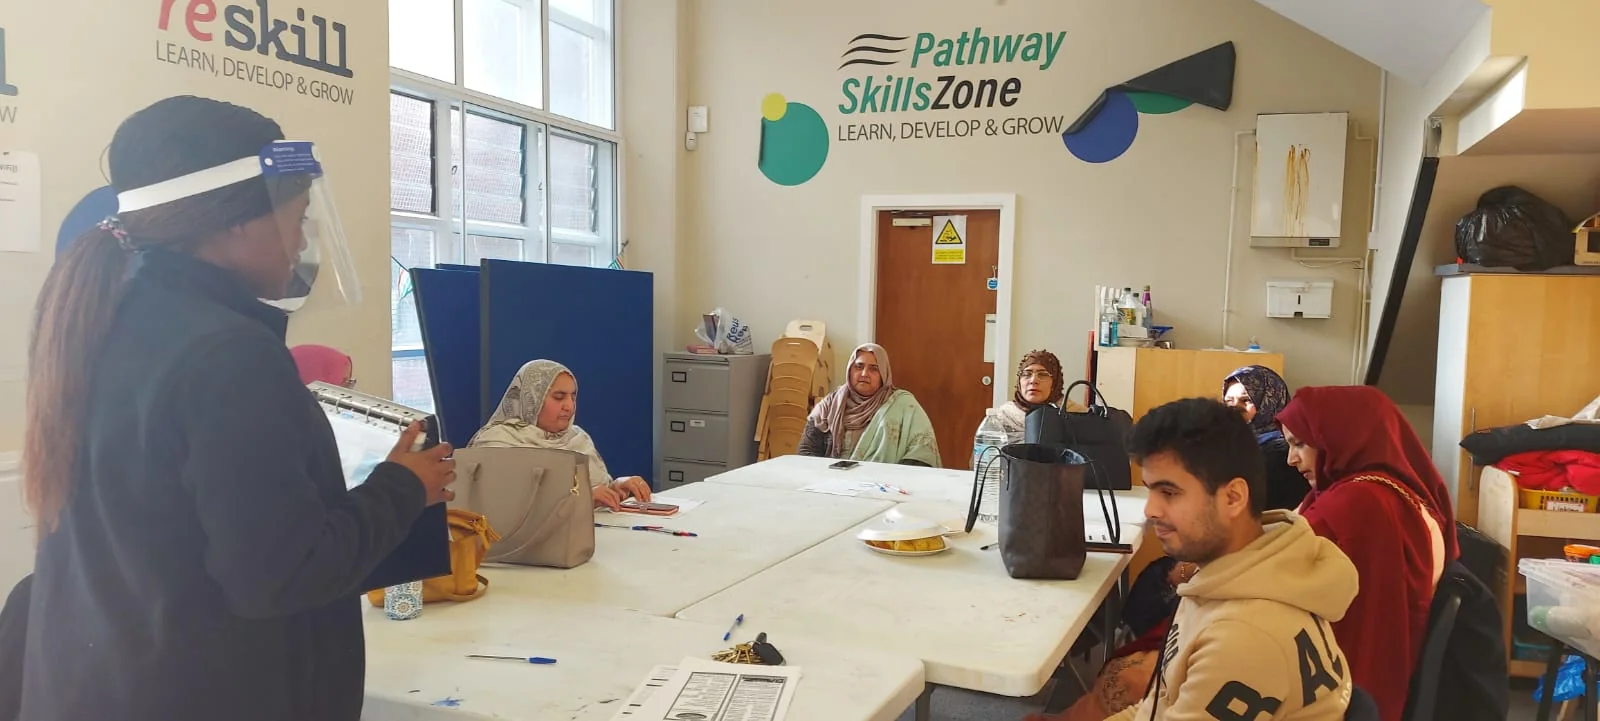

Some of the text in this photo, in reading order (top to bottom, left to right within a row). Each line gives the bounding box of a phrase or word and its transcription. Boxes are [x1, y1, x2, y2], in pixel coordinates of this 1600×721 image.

[911, 27, 1066, 70] Pathway
[156, 40, 354, 105] LEARN, DEVELOP & GROW
[838, 75, 1021, 114] SkillsZone
[838, 115, 1064, 142] LEARN, DEVELOP & GROW
